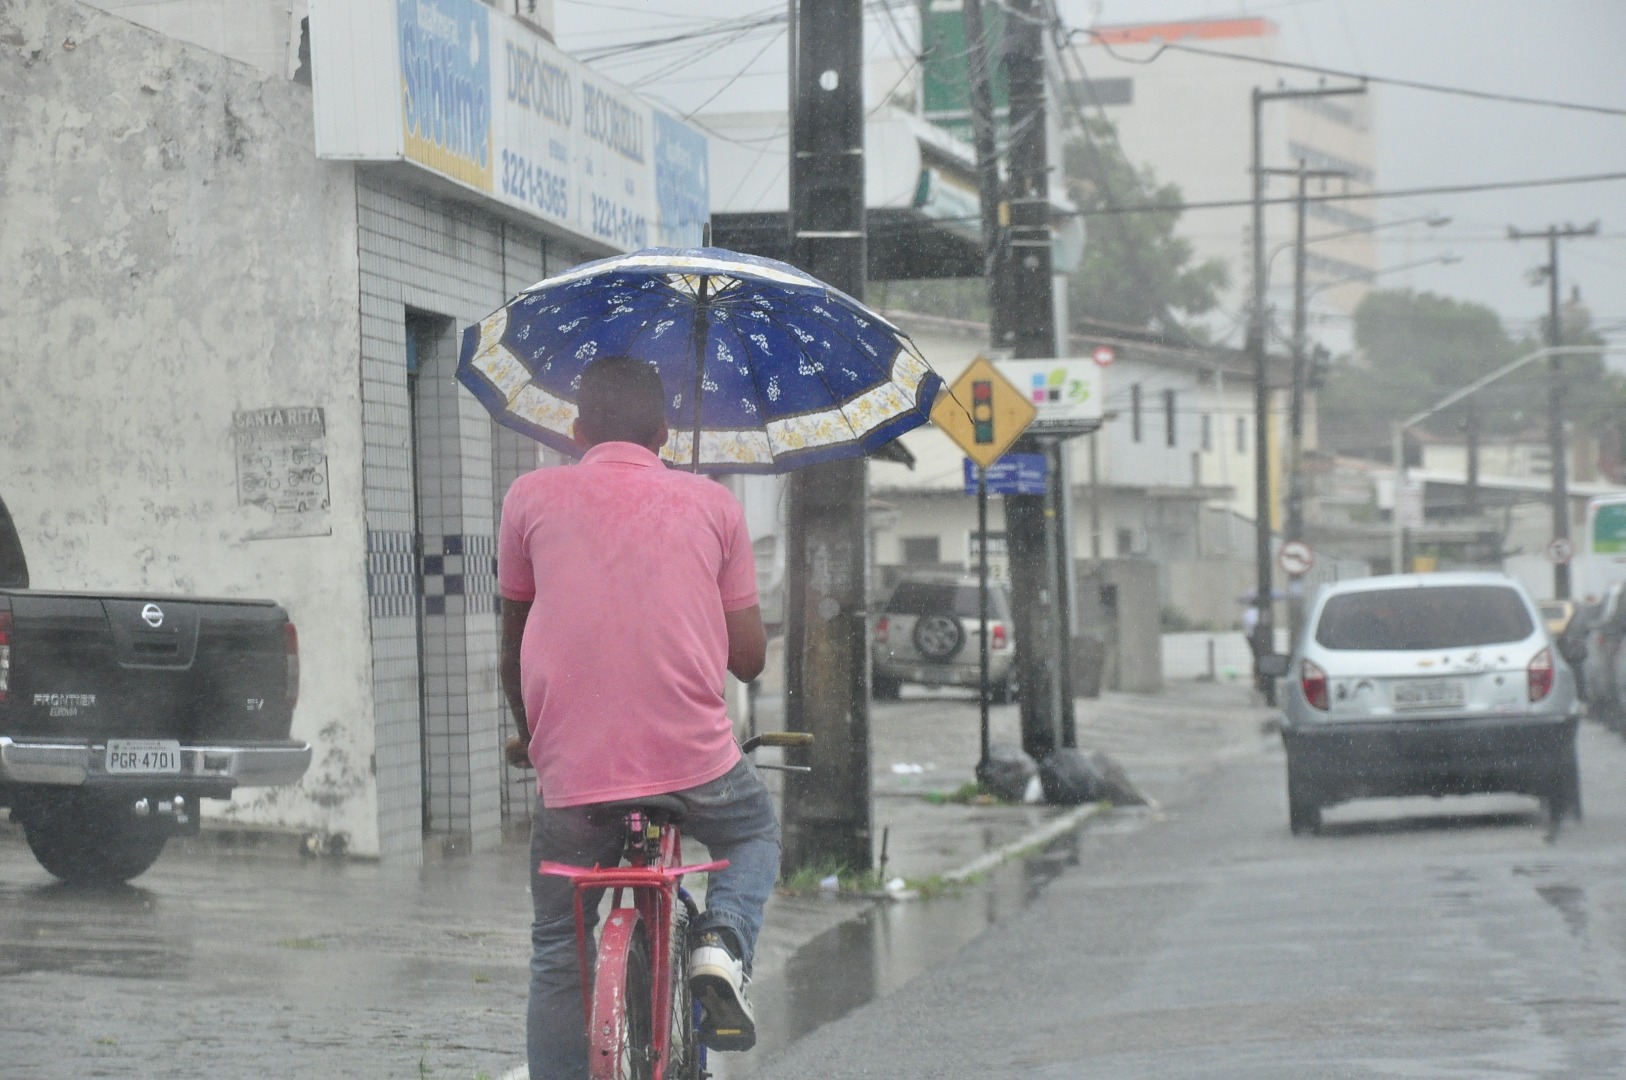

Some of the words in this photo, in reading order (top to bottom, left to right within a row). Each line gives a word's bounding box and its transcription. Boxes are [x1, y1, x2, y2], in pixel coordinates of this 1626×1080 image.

[235, 408, 284, 428] SANTA
[287, 407, 321, 426] RITA
[33, 693, 96, 706] FRONTIER
